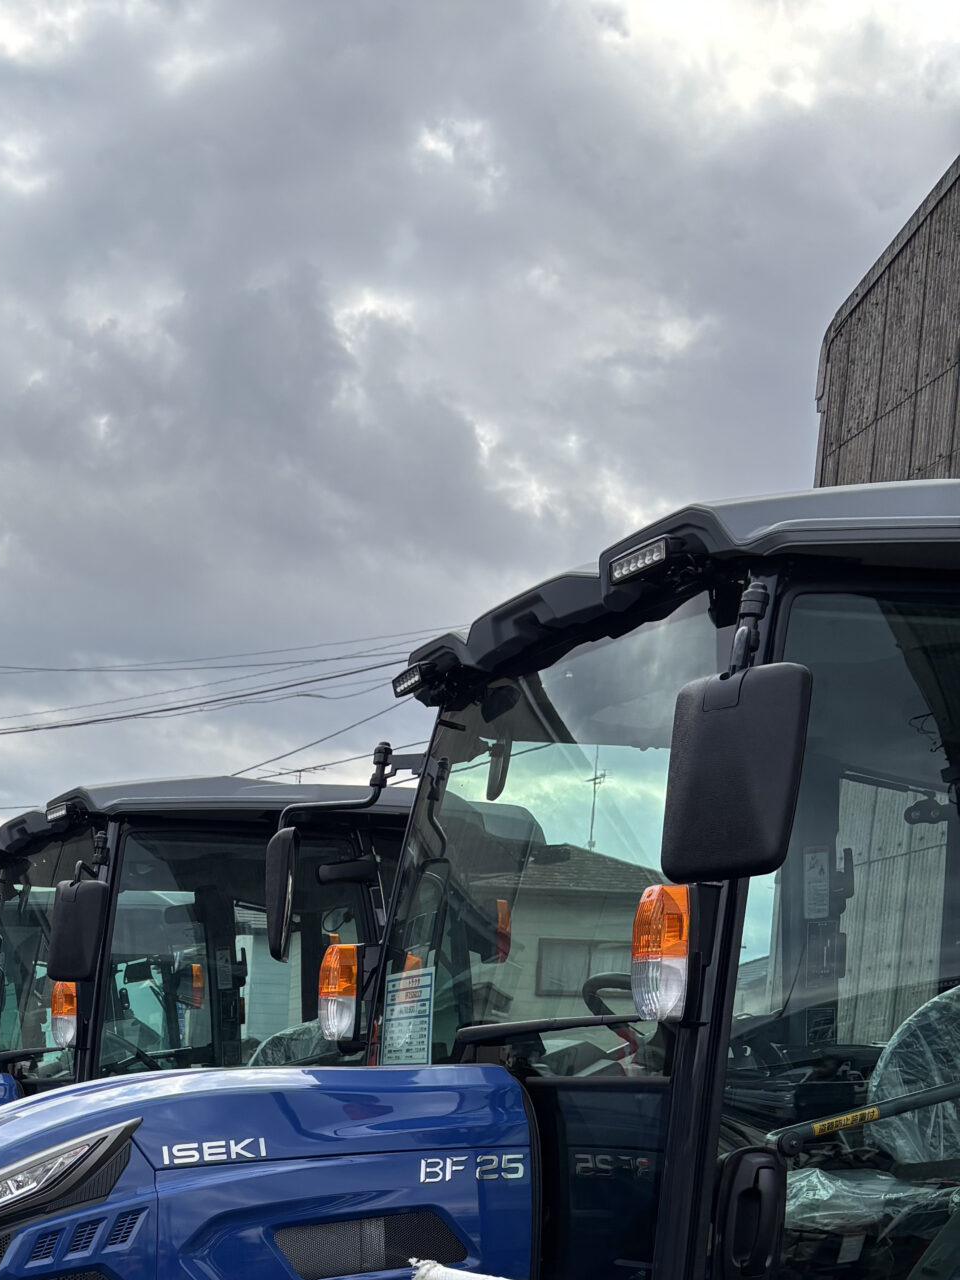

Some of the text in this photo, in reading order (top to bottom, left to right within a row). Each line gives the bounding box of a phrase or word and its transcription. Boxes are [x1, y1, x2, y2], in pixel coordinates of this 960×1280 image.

[162, 1137, 267, 1165] ISEKI
[420, 1154, 525, 1183] BF 25
